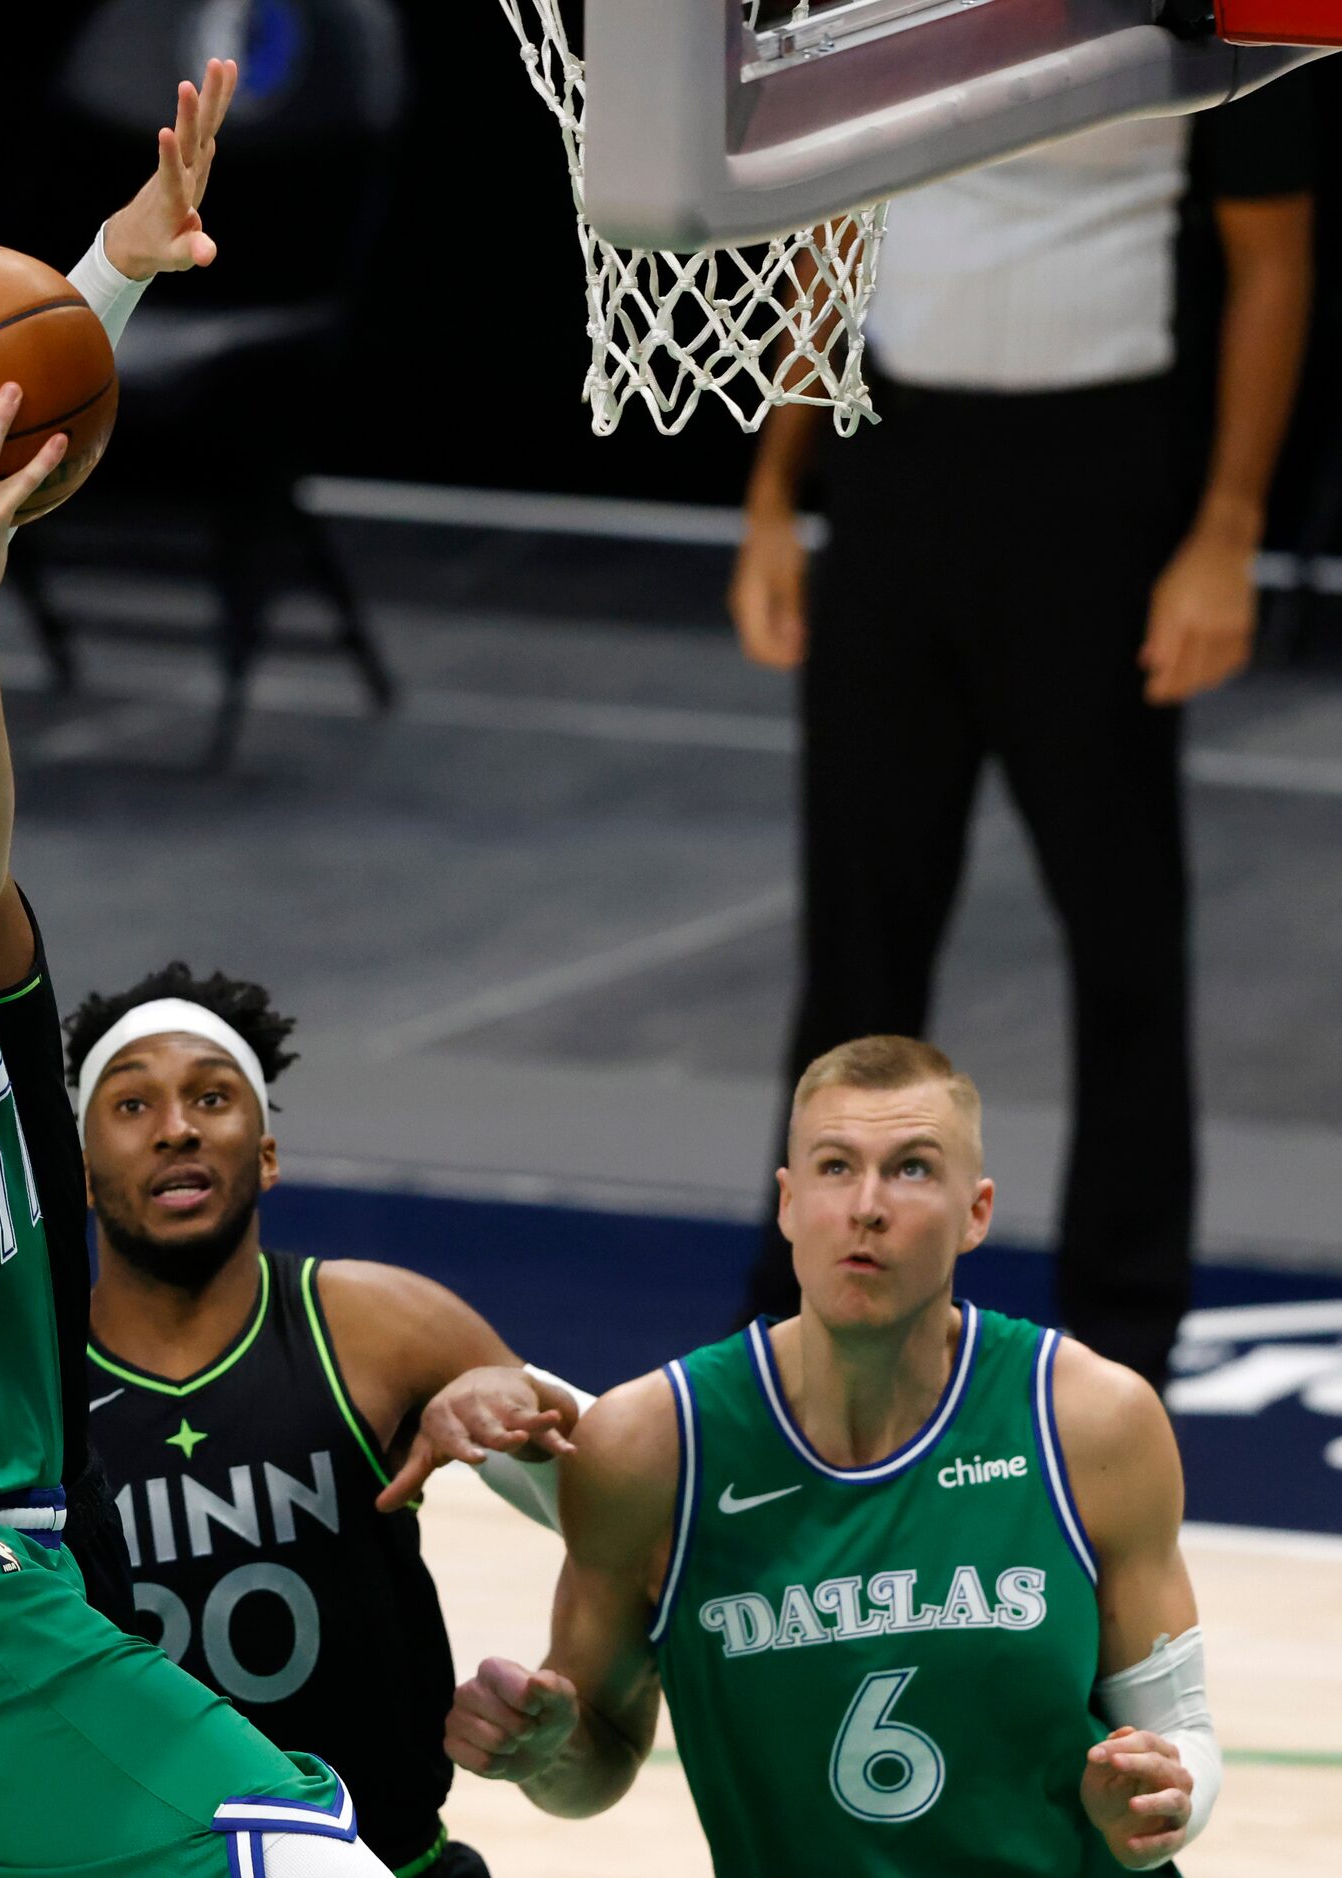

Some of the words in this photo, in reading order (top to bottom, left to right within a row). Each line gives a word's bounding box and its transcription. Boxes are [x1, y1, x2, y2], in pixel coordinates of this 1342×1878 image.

[938, 1455, 1028, 1488] chime
[2, 1562, 17, 1573] NBA
[699, 1565, 1047, 1658] DALLAS
[828, 1666, 946, 1823] 6
